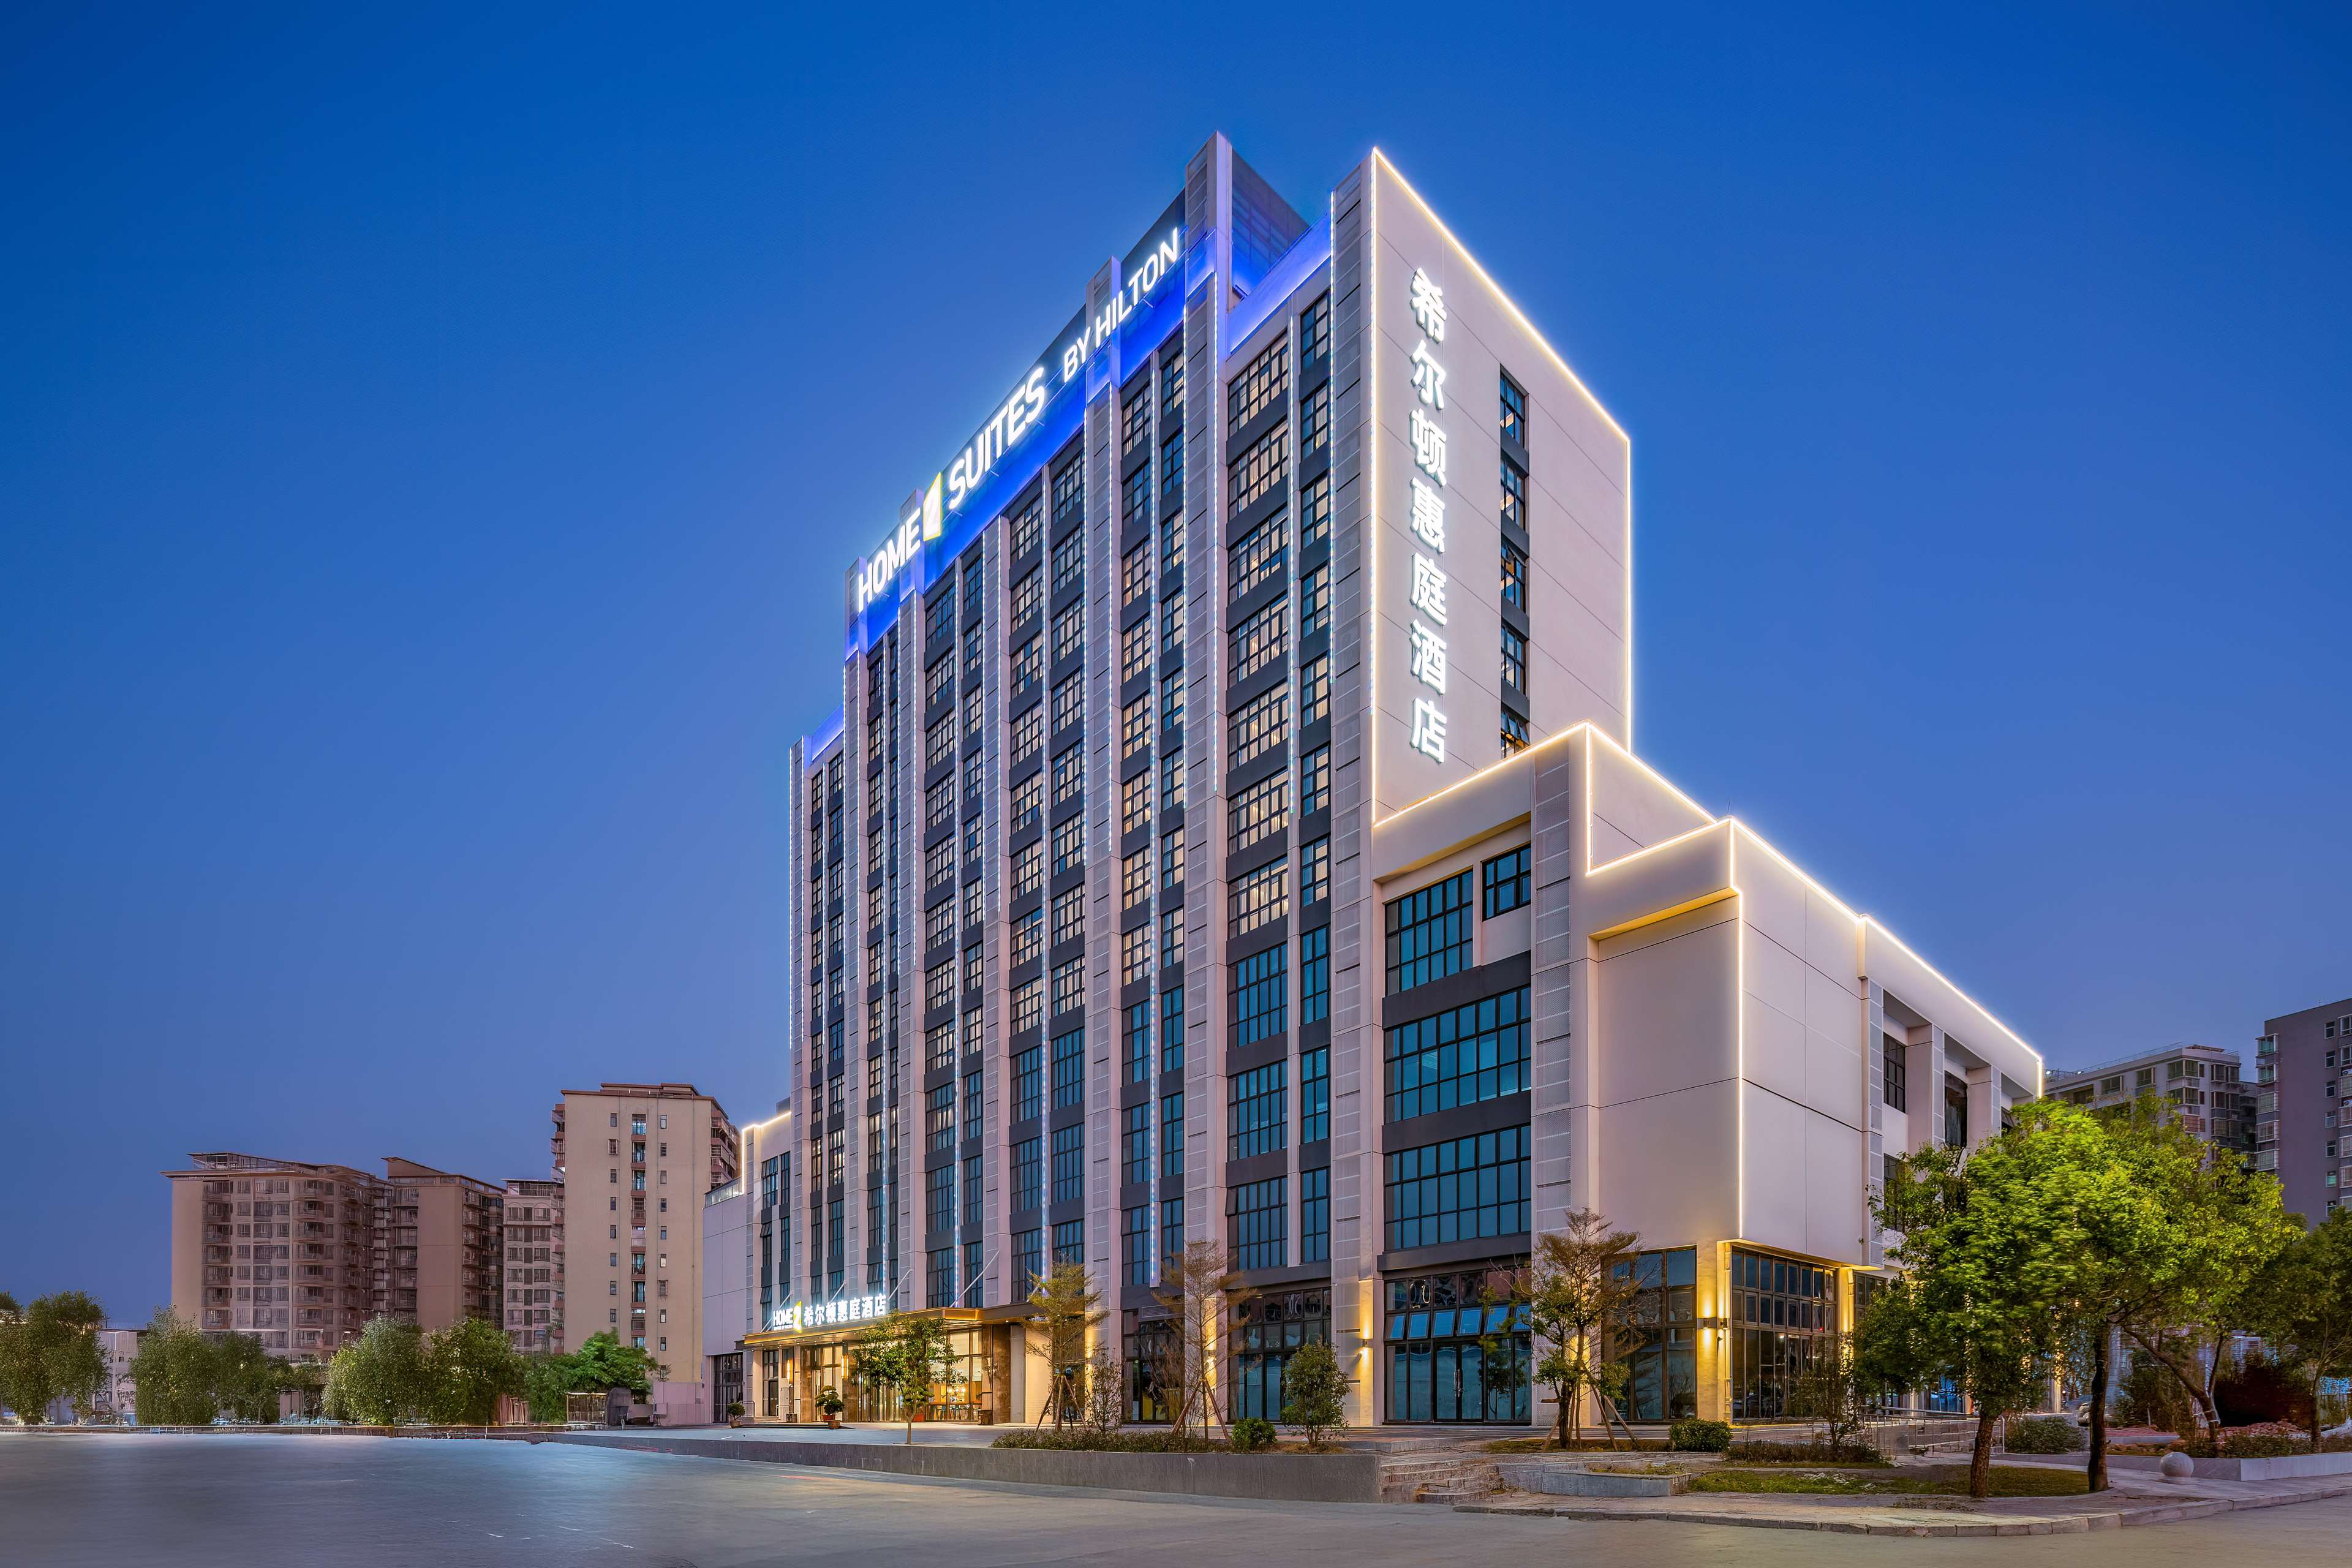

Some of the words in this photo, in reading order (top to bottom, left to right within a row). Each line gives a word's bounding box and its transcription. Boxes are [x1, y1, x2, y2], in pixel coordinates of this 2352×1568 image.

[858, 507, 921, 613] HOME
[949, 368, 1045, 509] SUITES
[1064, 326, 1091, 383] BY
[1096, 227, 1178, 348] HILTON
[1410, 267, 1447, 764] 希尔顿惠庭酒店
[773, 1308, 793, 1326] HOME
[793, 1303, 802, 1333] 2
[804, 1293, 886, 1327] 希尔顿惠庭酒店
